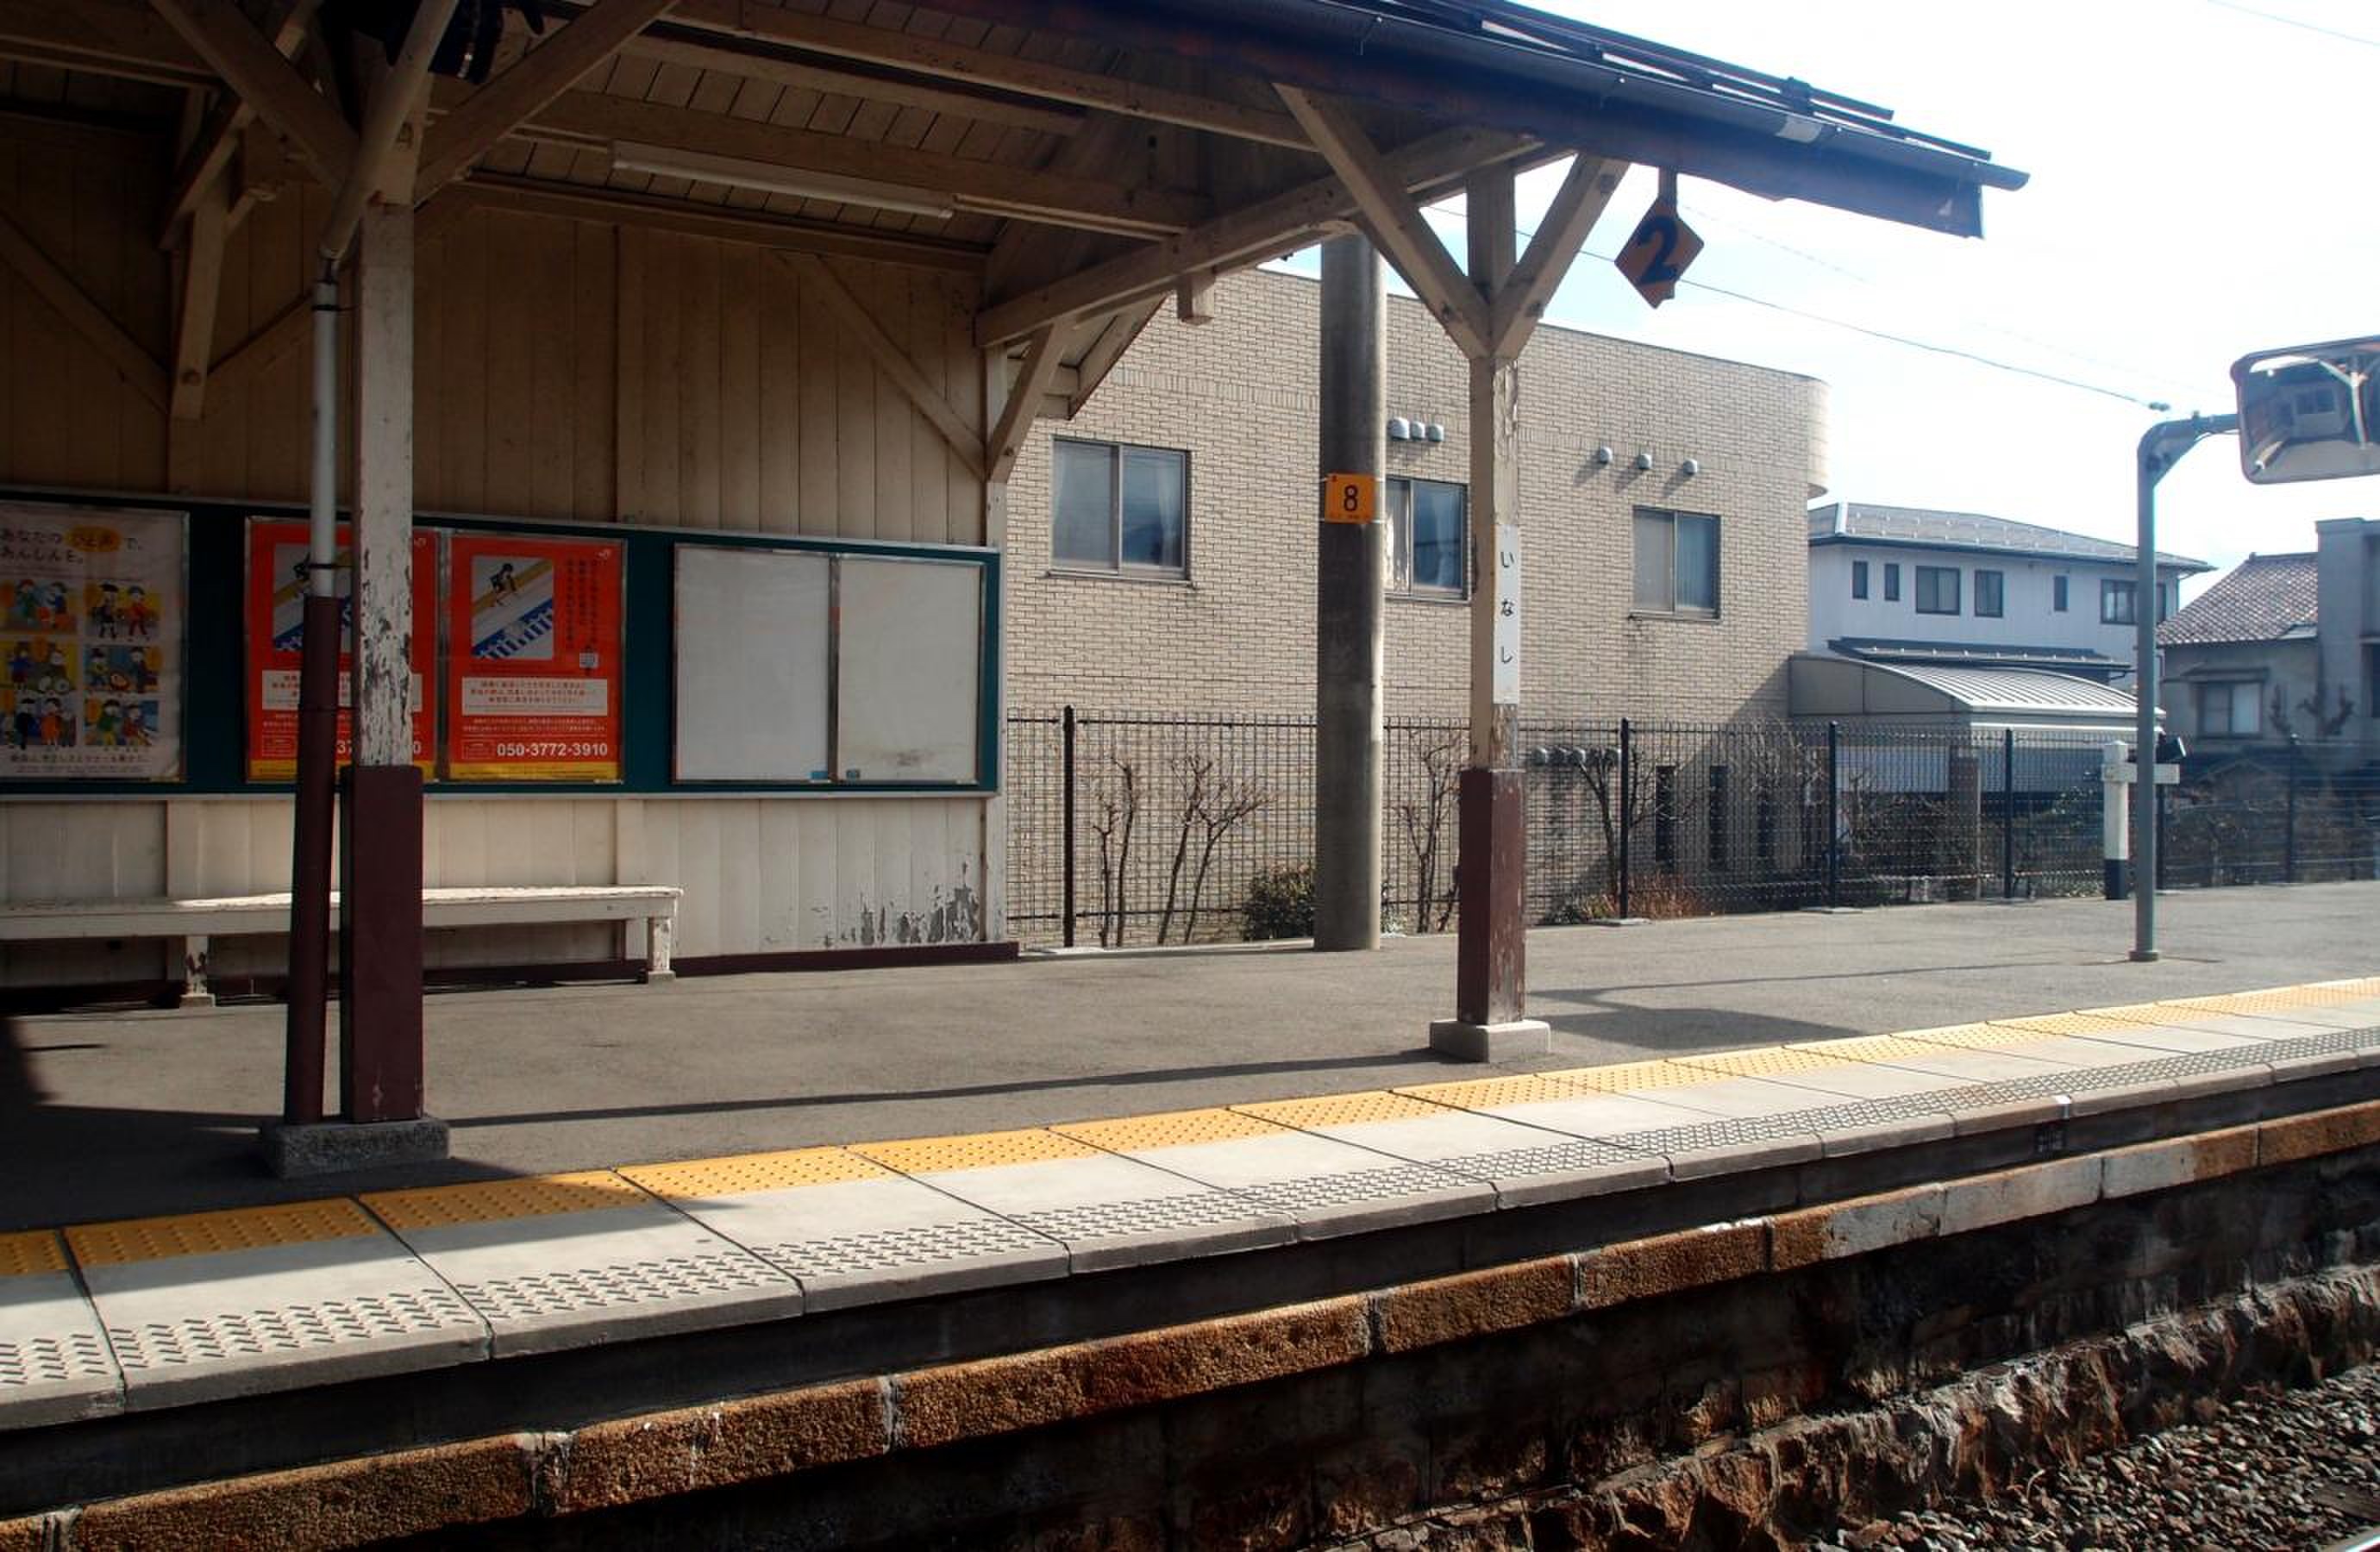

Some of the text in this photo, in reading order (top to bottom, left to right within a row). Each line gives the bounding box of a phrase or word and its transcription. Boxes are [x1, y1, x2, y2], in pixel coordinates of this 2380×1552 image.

[1638, 215, 1677, 285] 2
[1343, 485, 1358, 511] 8
[1500, 551, 1515, 664] いなし
[497, 742, 608, 757] 050-3772-3910
